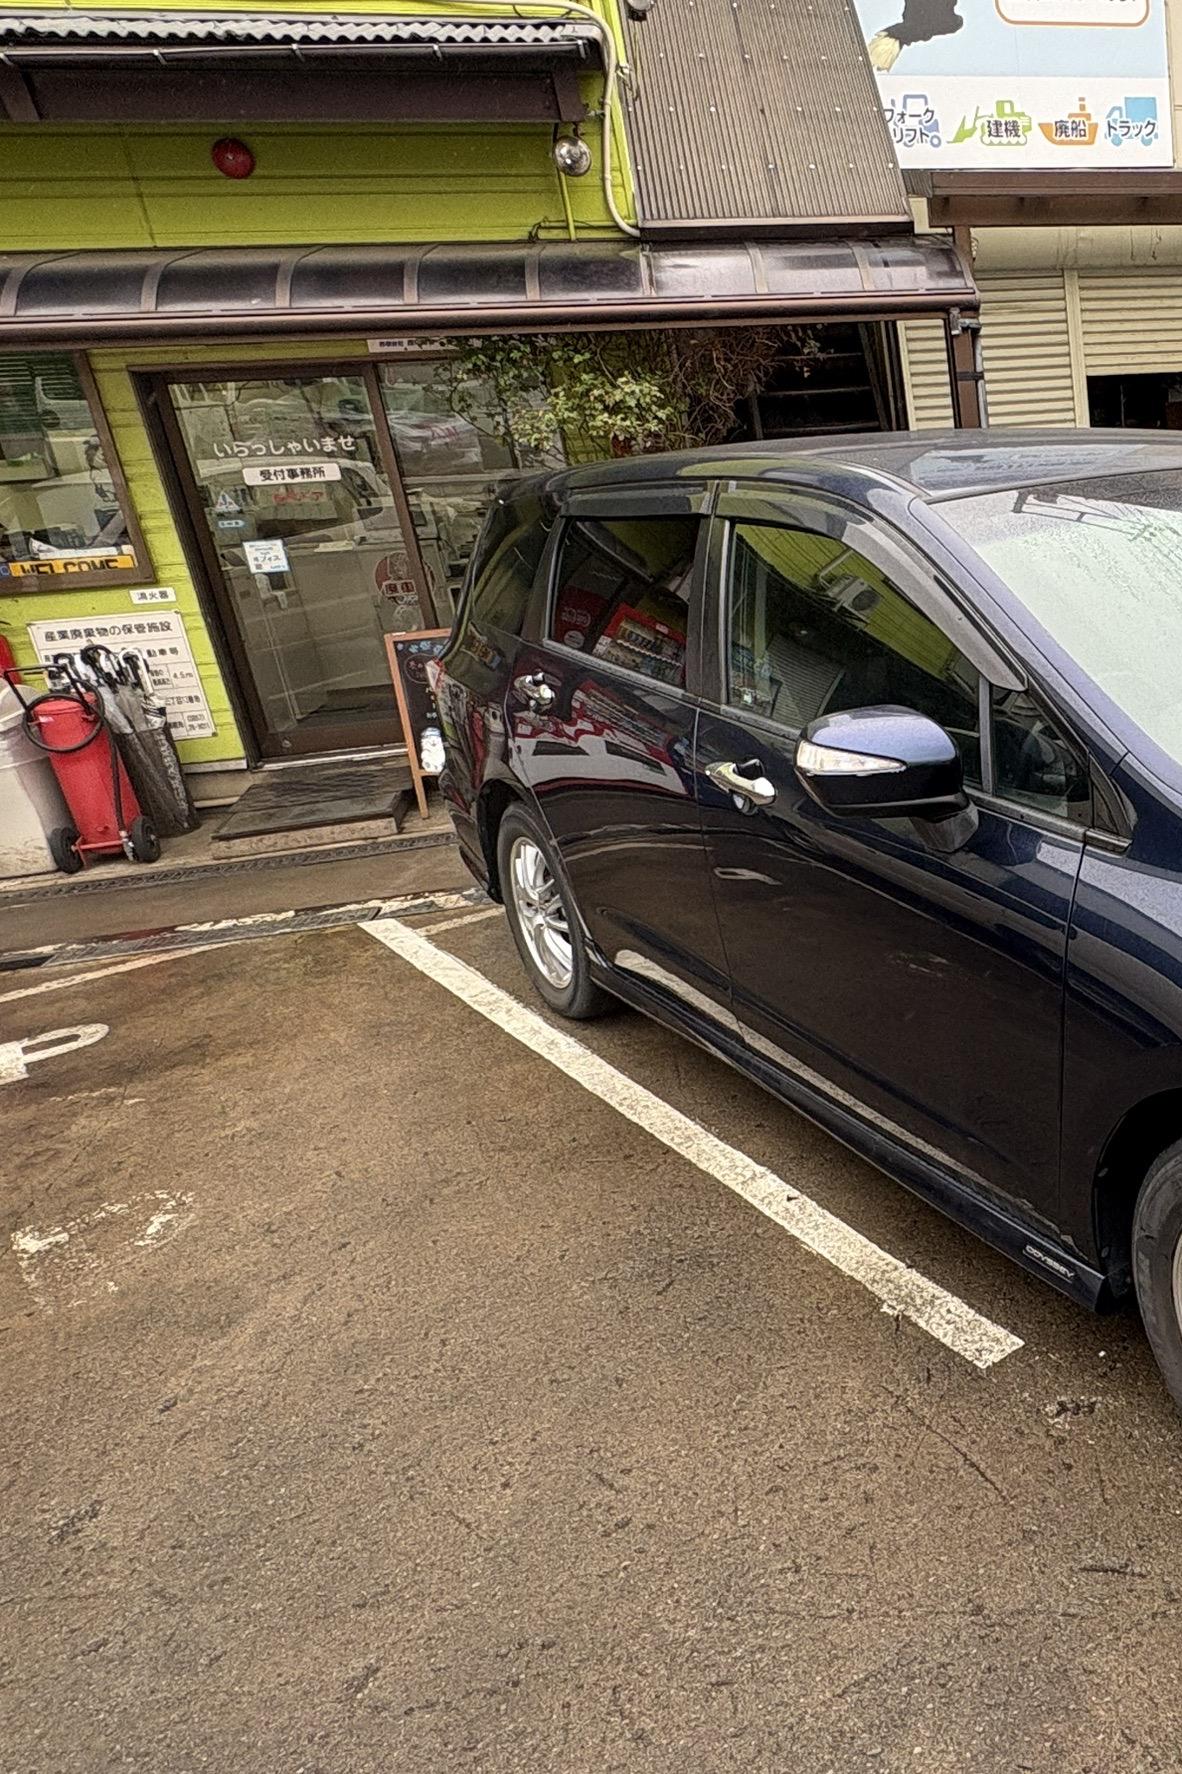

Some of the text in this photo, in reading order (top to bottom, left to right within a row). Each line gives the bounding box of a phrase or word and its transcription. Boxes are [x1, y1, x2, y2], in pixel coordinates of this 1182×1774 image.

[883, 107, 934, 124] フォーク
[893, 127, 929, 143] リフト
[987, 120, 1021, 138] 建機
[1054, 120, 1087, 138] 廃船
[1107, 120, 1156, 137] トラック
[213, 435, 356, 457] いらっしゃいませ
[259, 467, 326, 481] 受付事務所
[44, 621, 173, 642] 産業廃棄物の保管施設
